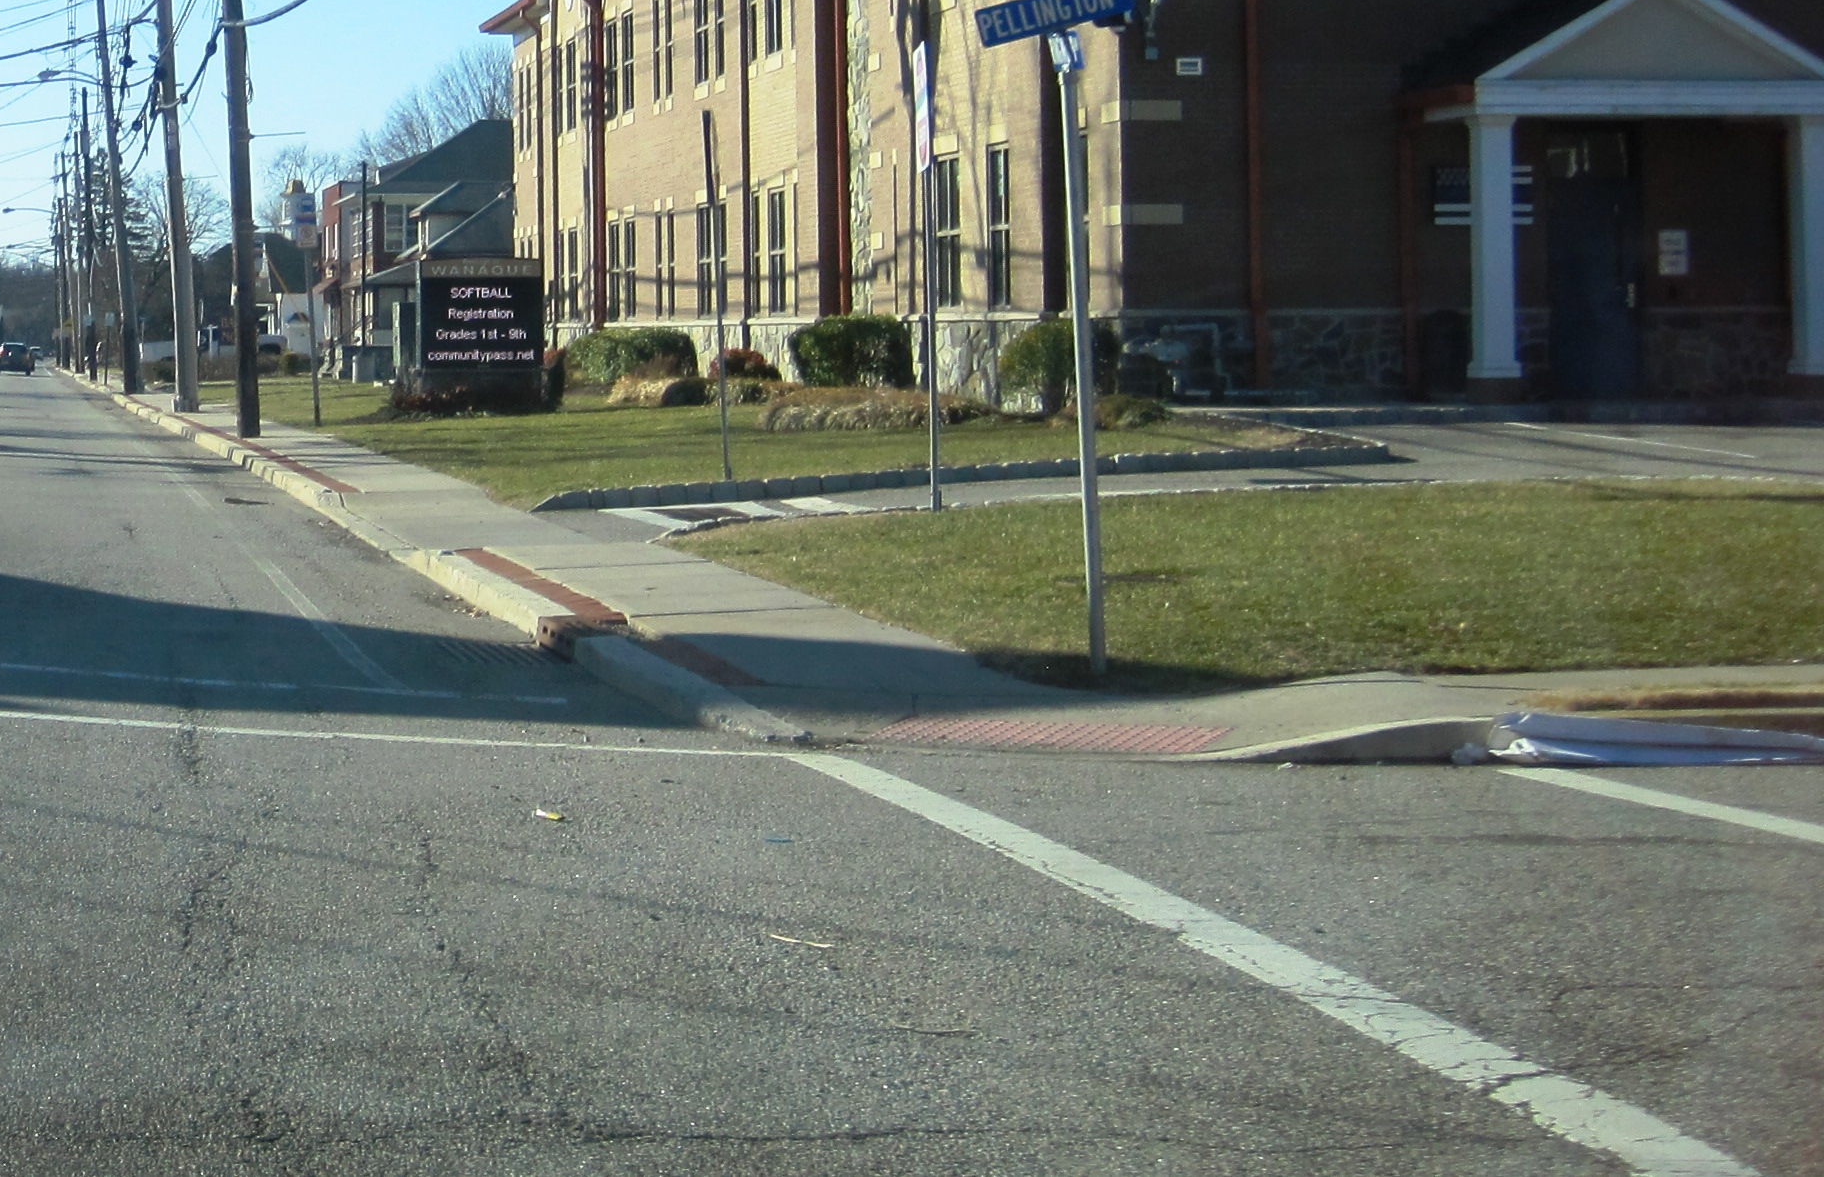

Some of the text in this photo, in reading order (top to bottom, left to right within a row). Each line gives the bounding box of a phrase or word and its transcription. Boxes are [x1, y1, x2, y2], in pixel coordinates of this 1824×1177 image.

[431, 265, 533, 276] WANAQUE
[450, 287, 513, 299] SOFTBALL
[448, 308, 514, 322] Registration
[436, 329, 477, 340] Grades
[480, 329, 498, 340] 1st
[427, 349, 535, 363] communitypass.net
